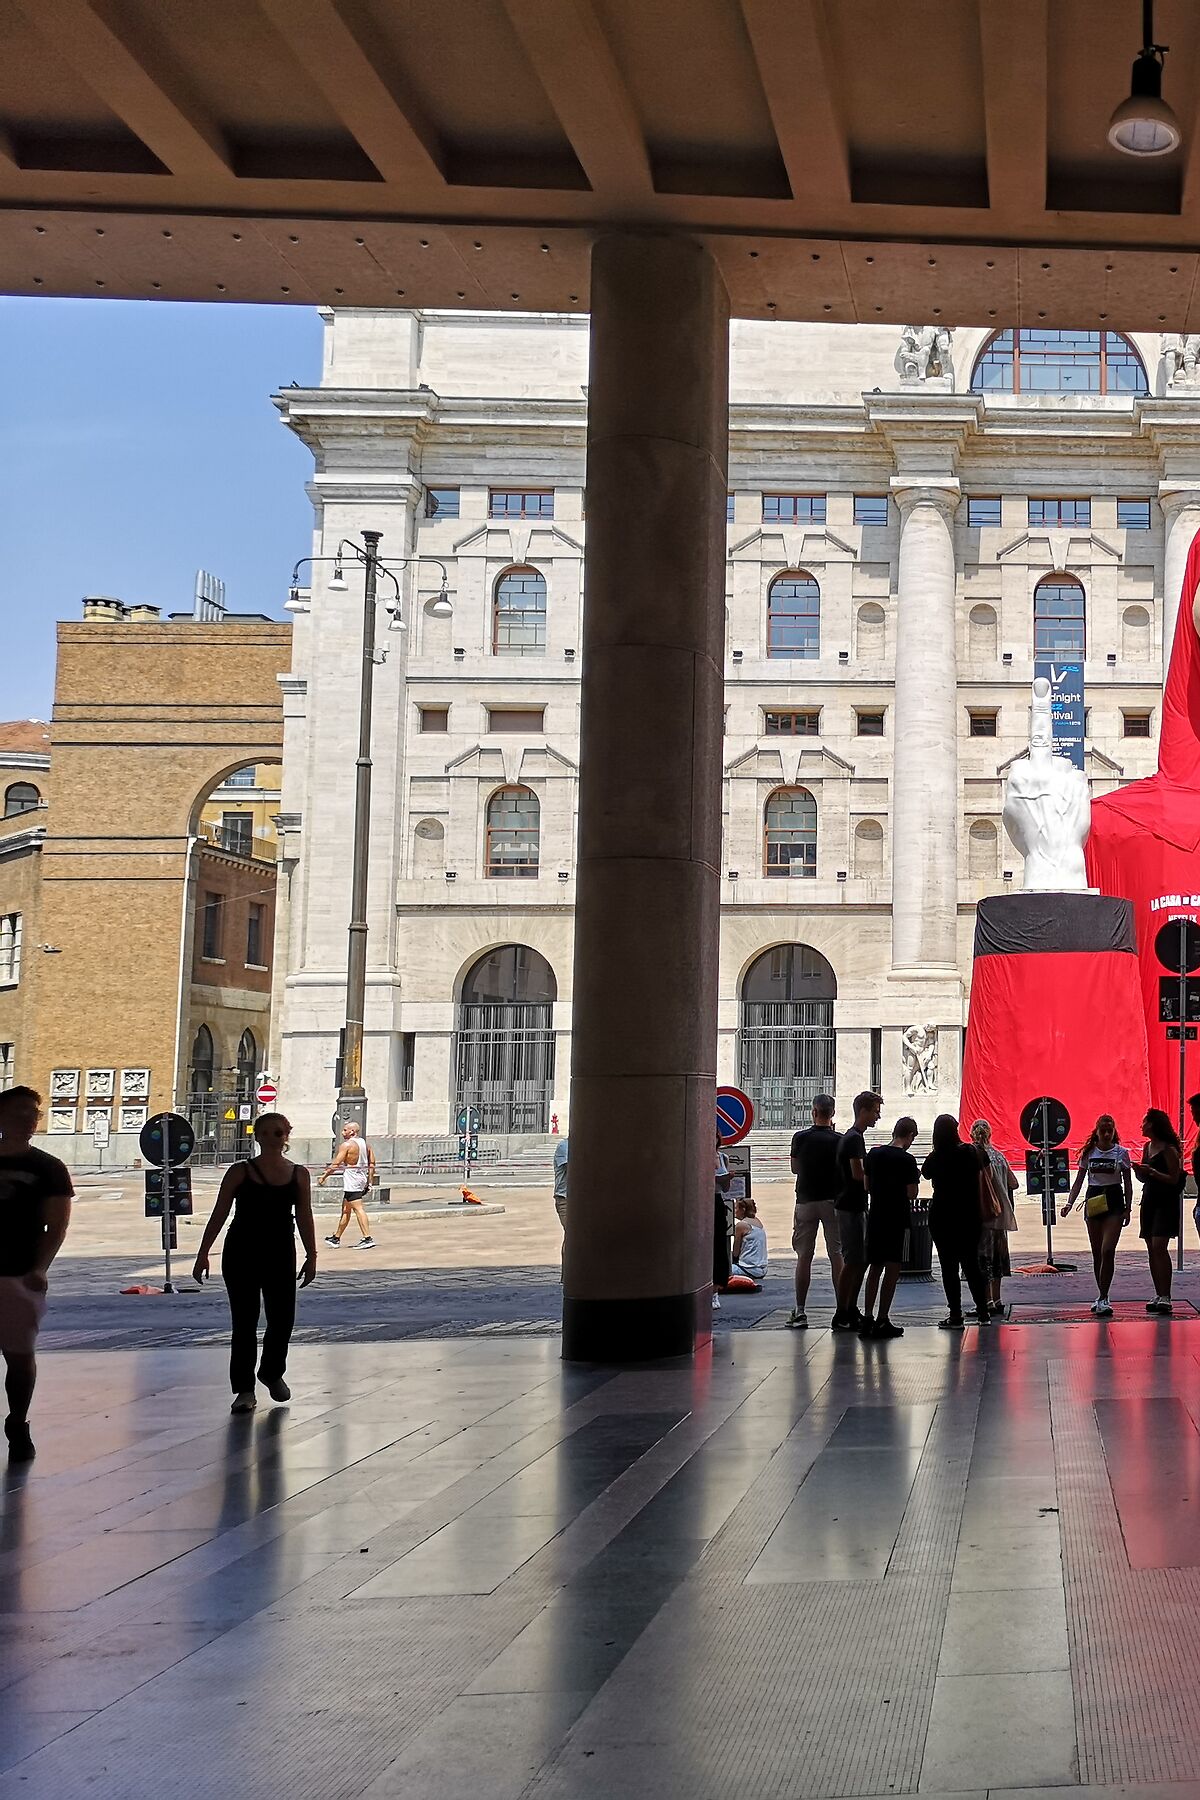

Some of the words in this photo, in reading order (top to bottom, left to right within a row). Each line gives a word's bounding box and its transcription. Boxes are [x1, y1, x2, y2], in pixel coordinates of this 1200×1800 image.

[1051, 694, 1080, 703] dnight
[1151, 899, 1160, 911] LA
[1160, 895, 1181, 908] CASA
